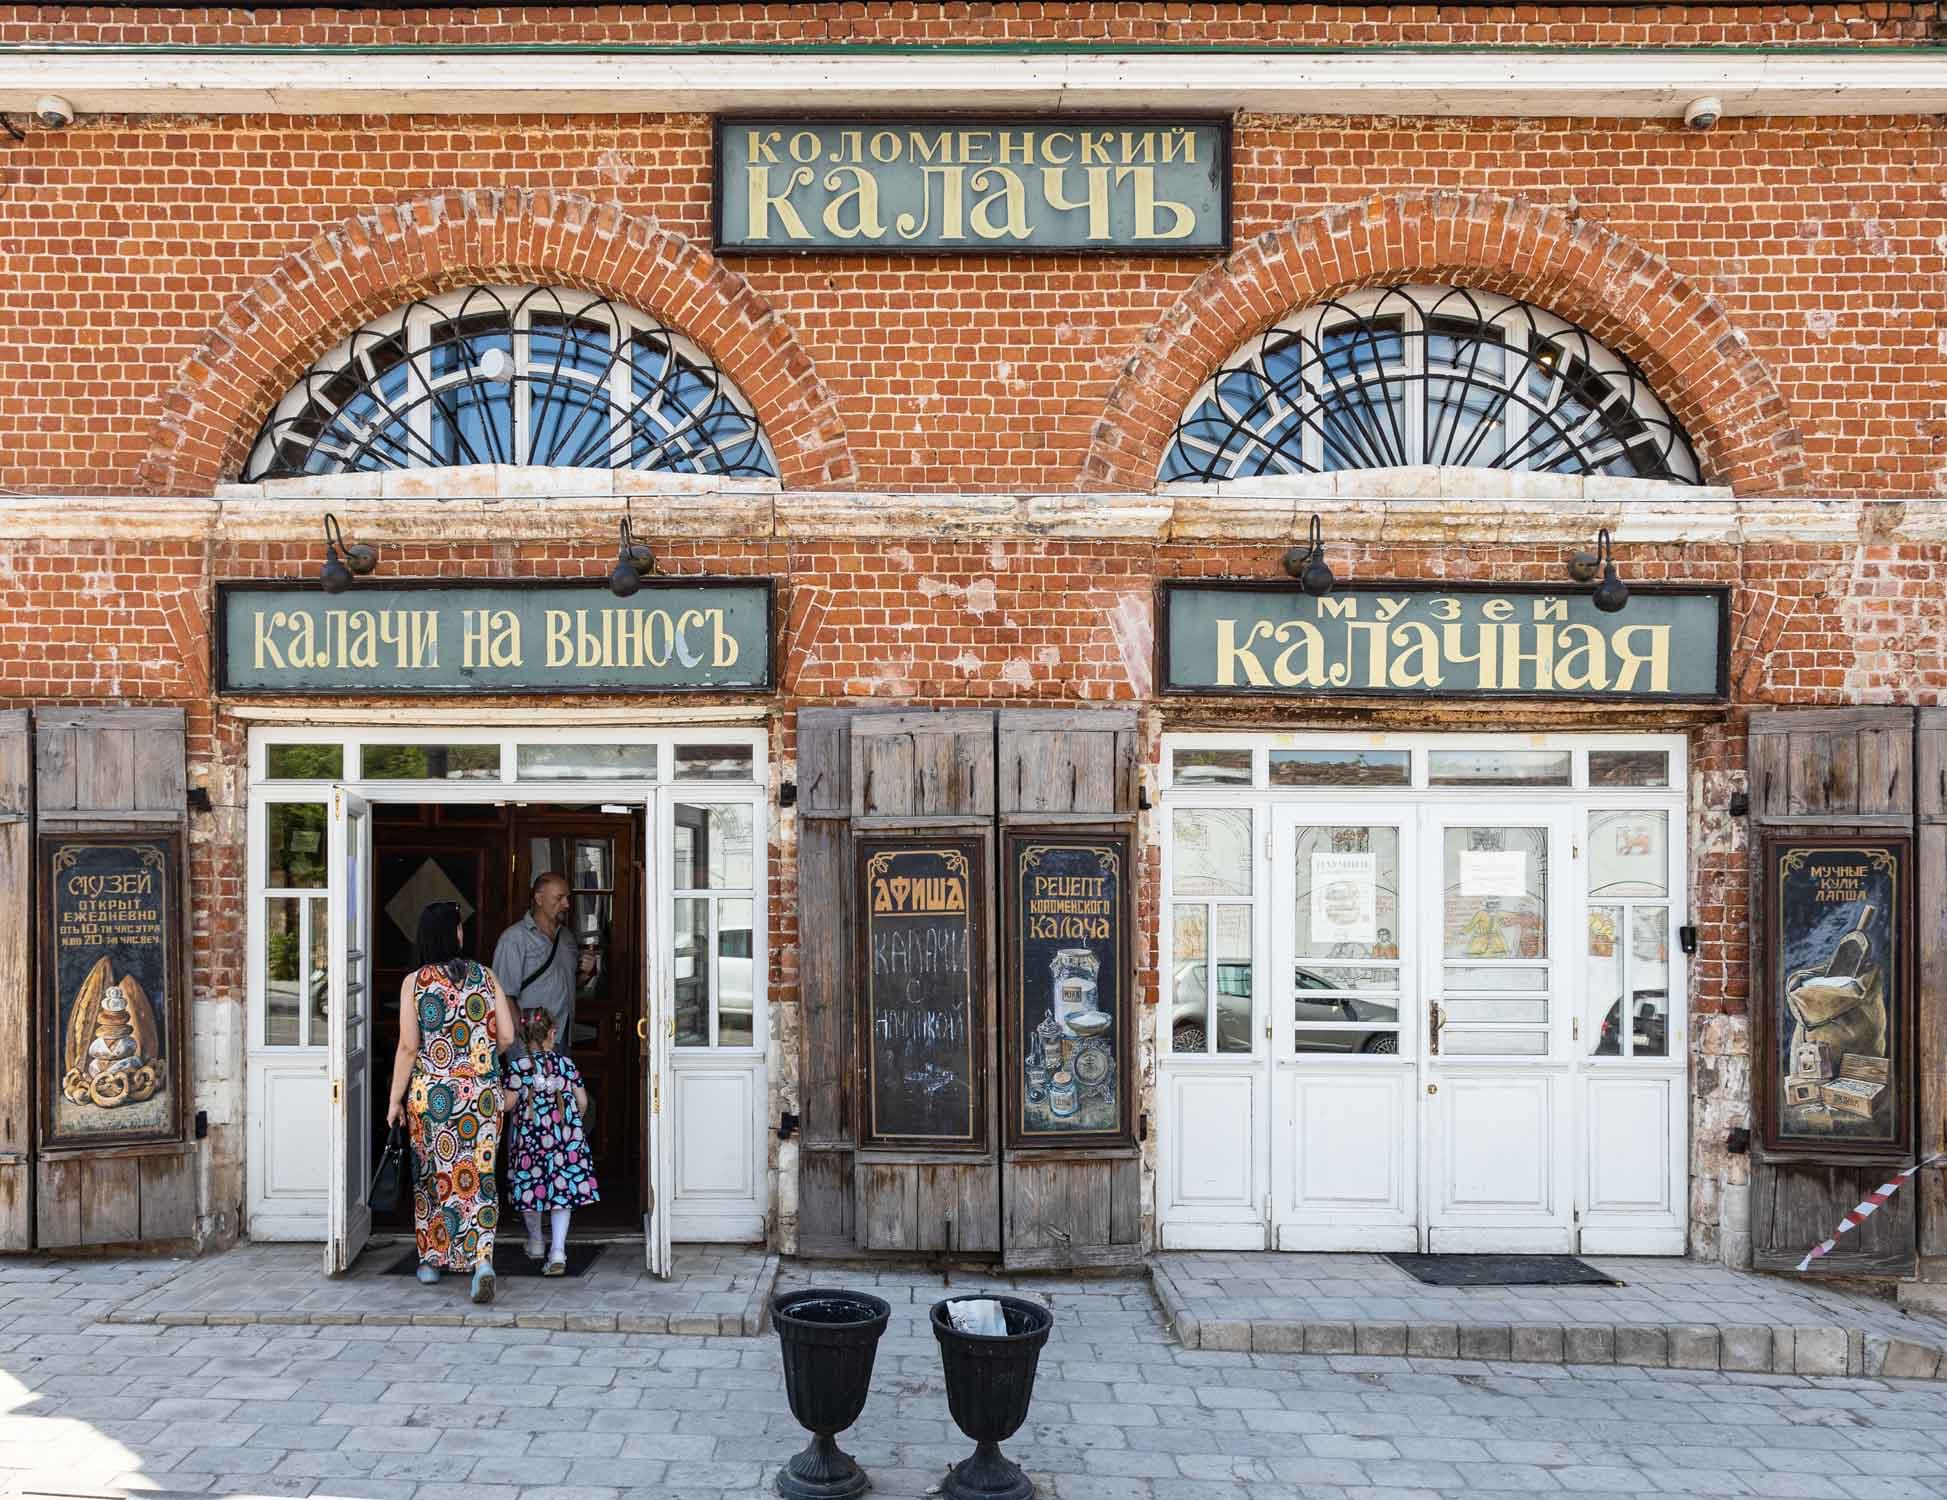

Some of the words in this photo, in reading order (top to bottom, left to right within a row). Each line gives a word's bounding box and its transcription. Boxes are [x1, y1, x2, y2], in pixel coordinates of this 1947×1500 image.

[745, 127, 1198, 164] КОЛОМЕНСКИЙ
[463, 609, 524, 668] на
[1810, 865, 1869, 878] МУЧНЫЕ
[68, 870, 151, 897] МУЗЕЙ
[1034, 876, 1105, 897] РЕЦЕПТ
[874, 876, 966, 912] АФИША
[1815, 890, 1867, 902] ЛАПША
[79, 899, 142, 911] ОТКРЫТ
[1030, 900, 1110, 914] КОЛОМЕНСКОГО
[63, 910, 157, 922] ЕЖЕДНЕВНО
